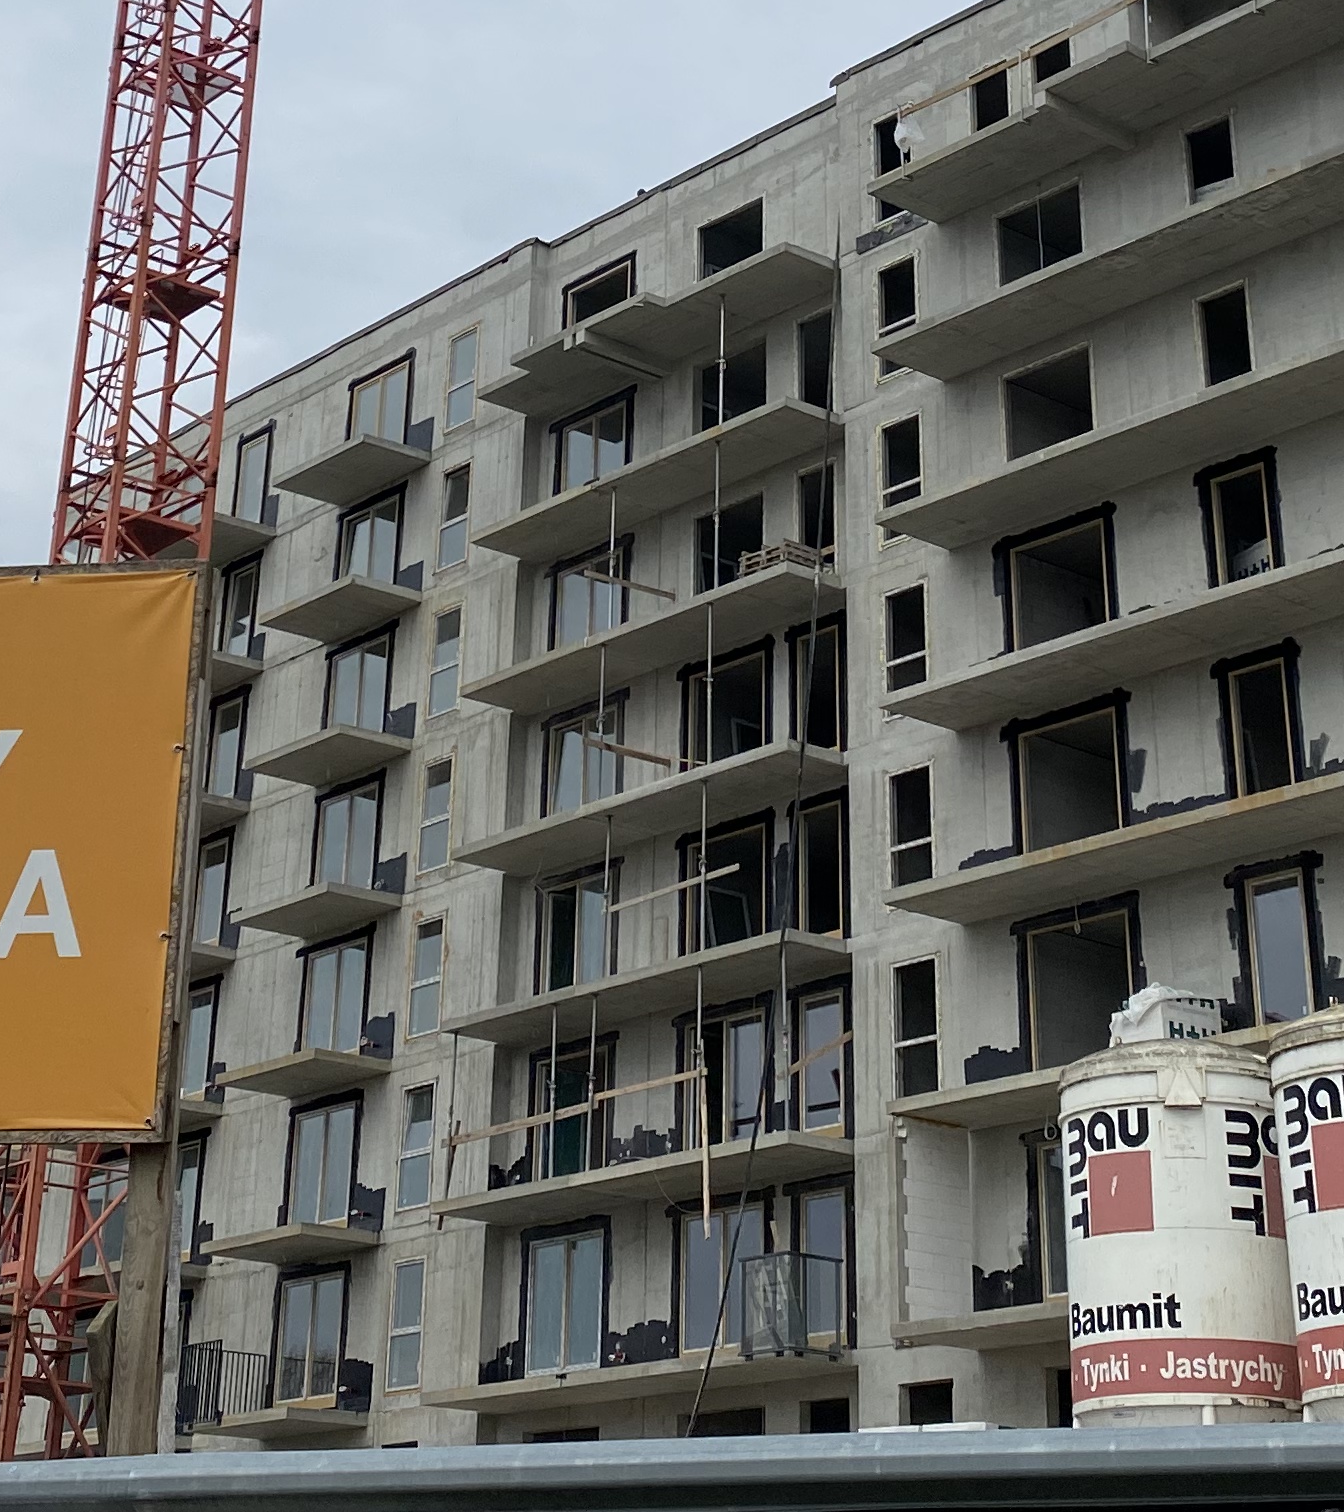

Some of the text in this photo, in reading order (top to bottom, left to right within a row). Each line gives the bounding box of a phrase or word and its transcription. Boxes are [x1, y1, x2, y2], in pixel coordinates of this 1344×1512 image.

[1071, 1292, 1182, 1339] Baumit
[1081, 1350, 1285, 1392] Tynki Jastrychy
